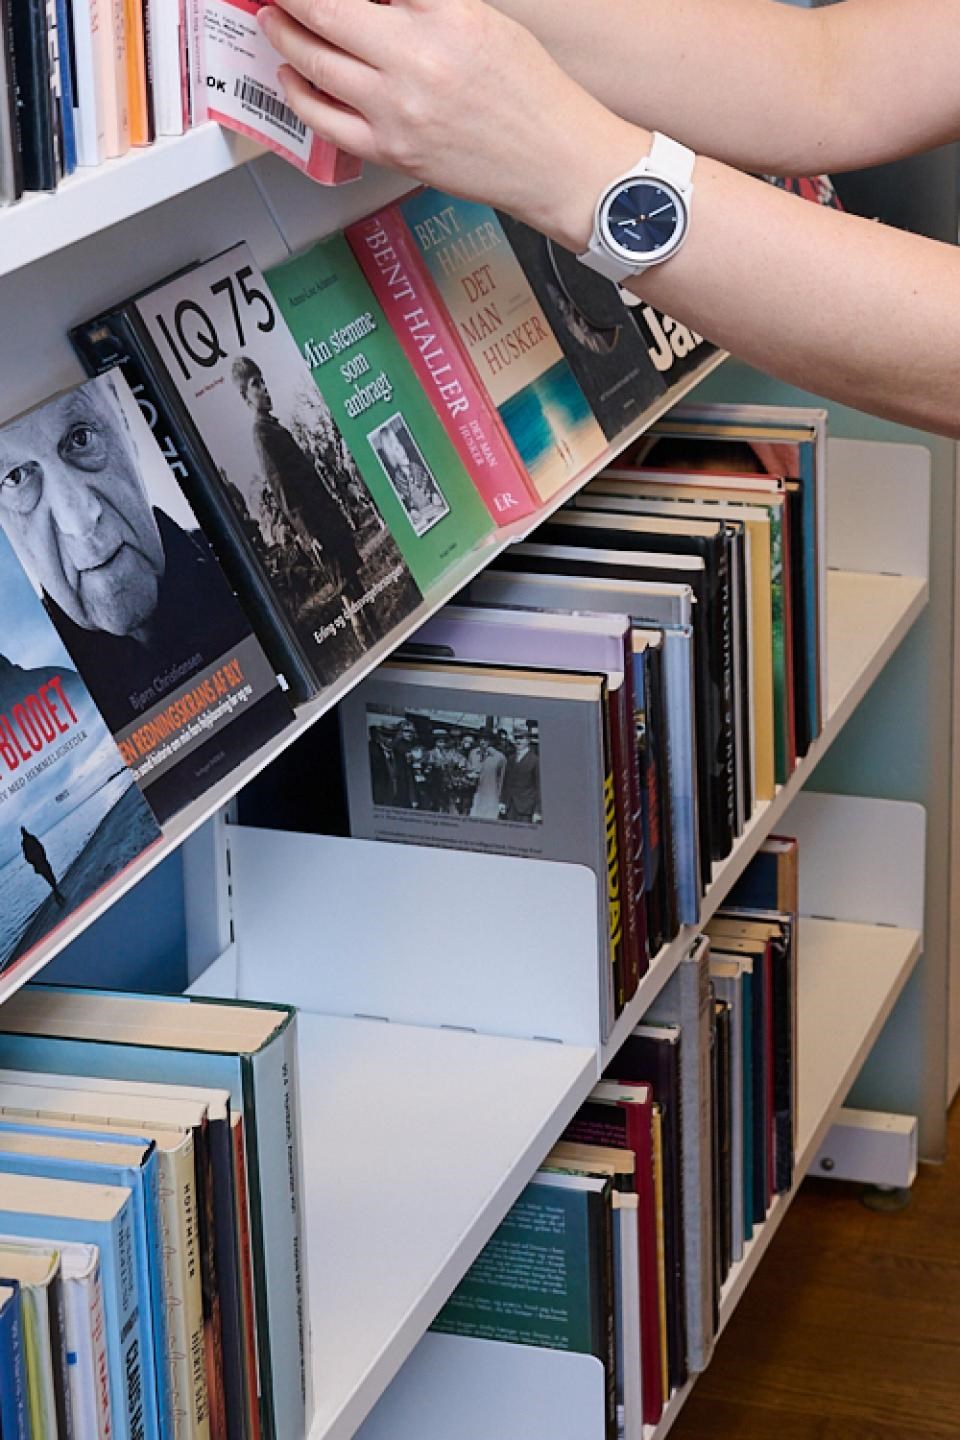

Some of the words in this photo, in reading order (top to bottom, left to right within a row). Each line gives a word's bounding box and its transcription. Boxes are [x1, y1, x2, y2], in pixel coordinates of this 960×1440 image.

[414, 206, 465, 251] BENT
[436, 221, 502, 276] HALLER
[461, 264, 498, 304] DET
[155, 298, 228, 381] IQ
[210, 265, 275, 348] 75
[329, 311, 377, 357] stemme
[365, 230, 416, 302] BENT
[403, 308, 471, 419] HALLER
[460, 302, 504, 347] MAN
[482, 315, 549, 375] HUSKER
[340, 353, 370, 383] som
[344, 371, 393, 419] anbragt
